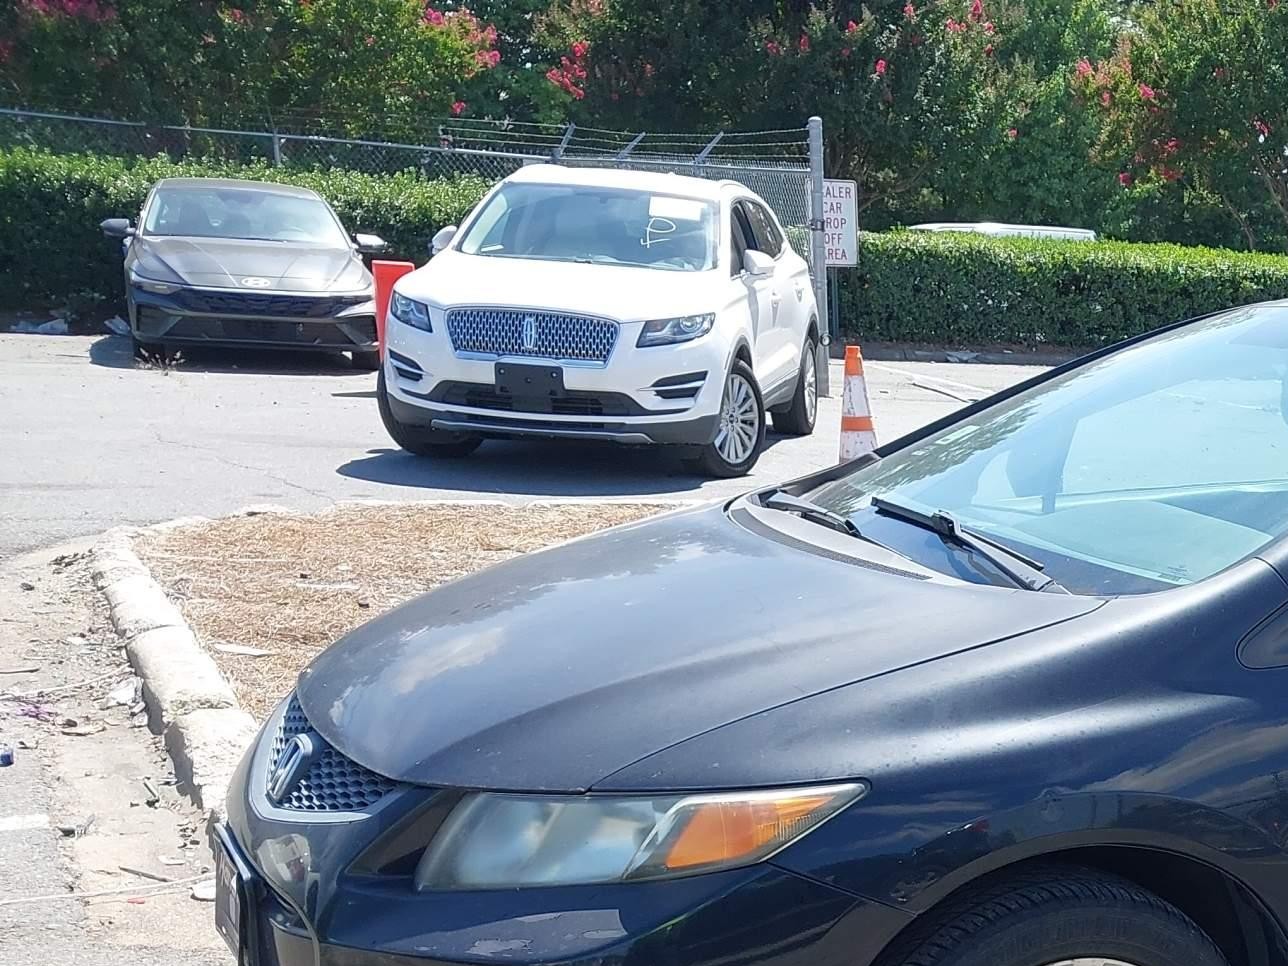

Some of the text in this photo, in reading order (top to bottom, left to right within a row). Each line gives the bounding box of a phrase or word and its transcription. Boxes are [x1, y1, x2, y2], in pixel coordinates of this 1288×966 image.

[824, 186, 852, 199] ALER
[826, 217, 847, 229] ROP
[824, 233, 843, 245] OFF
[826, 248, 848, 260] REA
